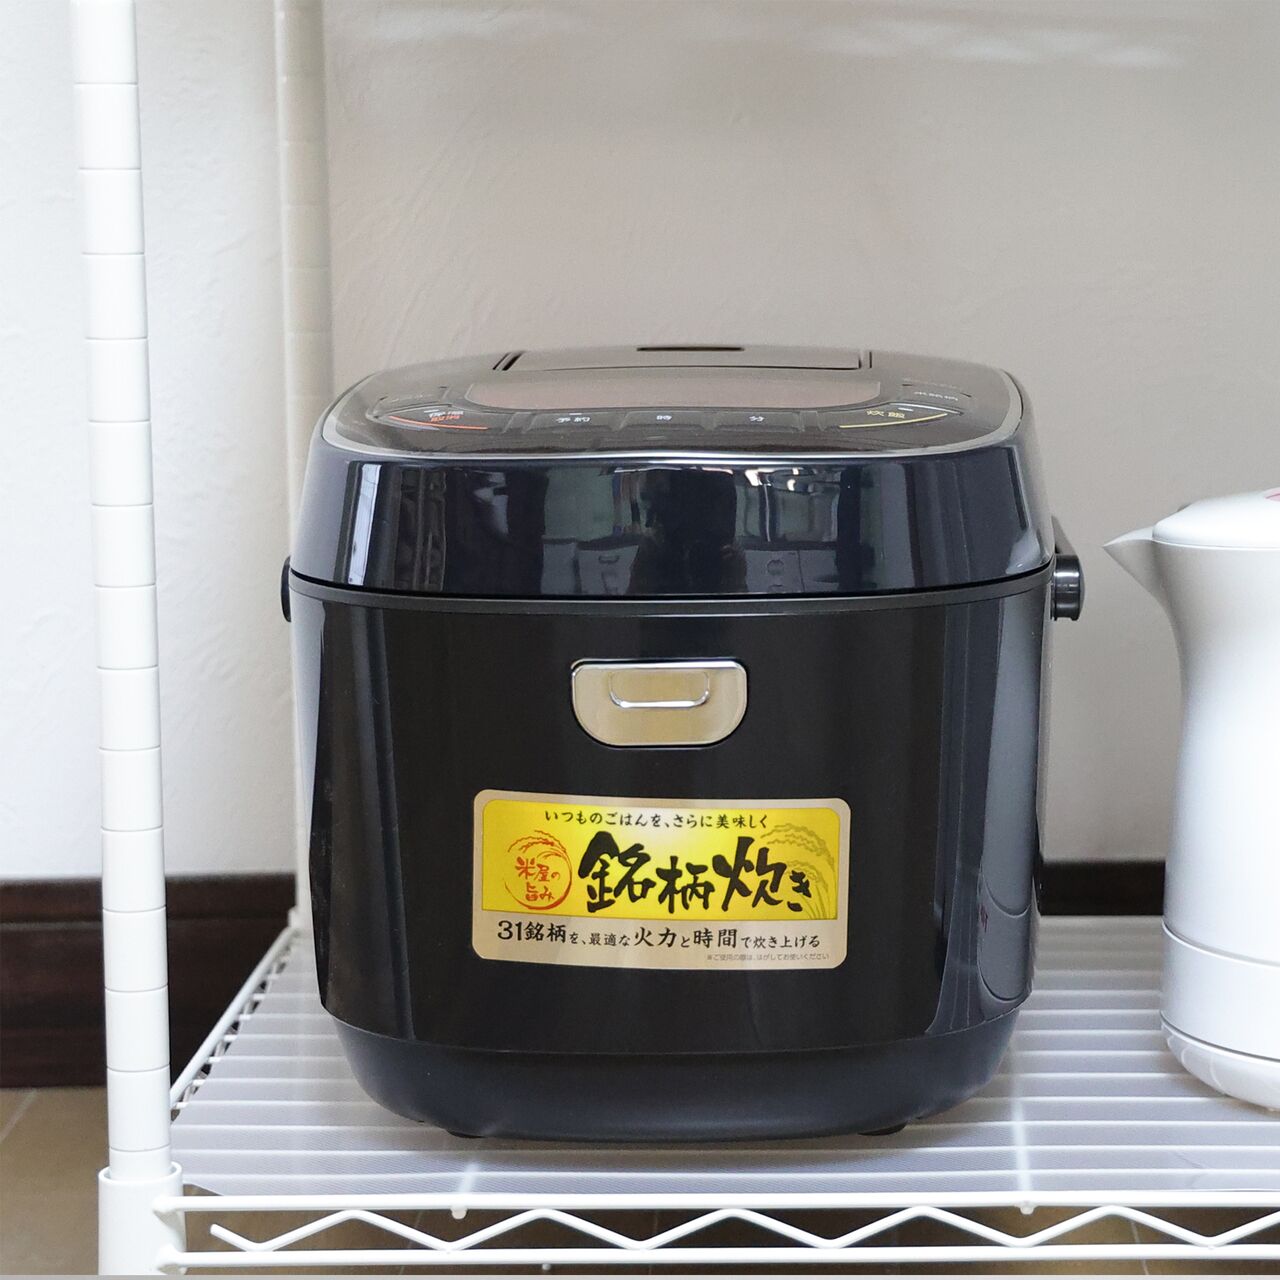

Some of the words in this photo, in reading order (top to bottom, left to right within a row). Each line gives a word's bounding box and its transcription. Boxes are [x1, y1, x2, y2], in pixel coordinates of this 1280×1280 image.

[544, 809, 770, 829] いつものごはんを、さらに美味しく
[514, 855, 561, 882] 米屋の
[578, 830, 813, 914] 銘柄炊き
[496, 919, 821, 950] 31銘柄を、最適な火力と時間で炊き上げる
